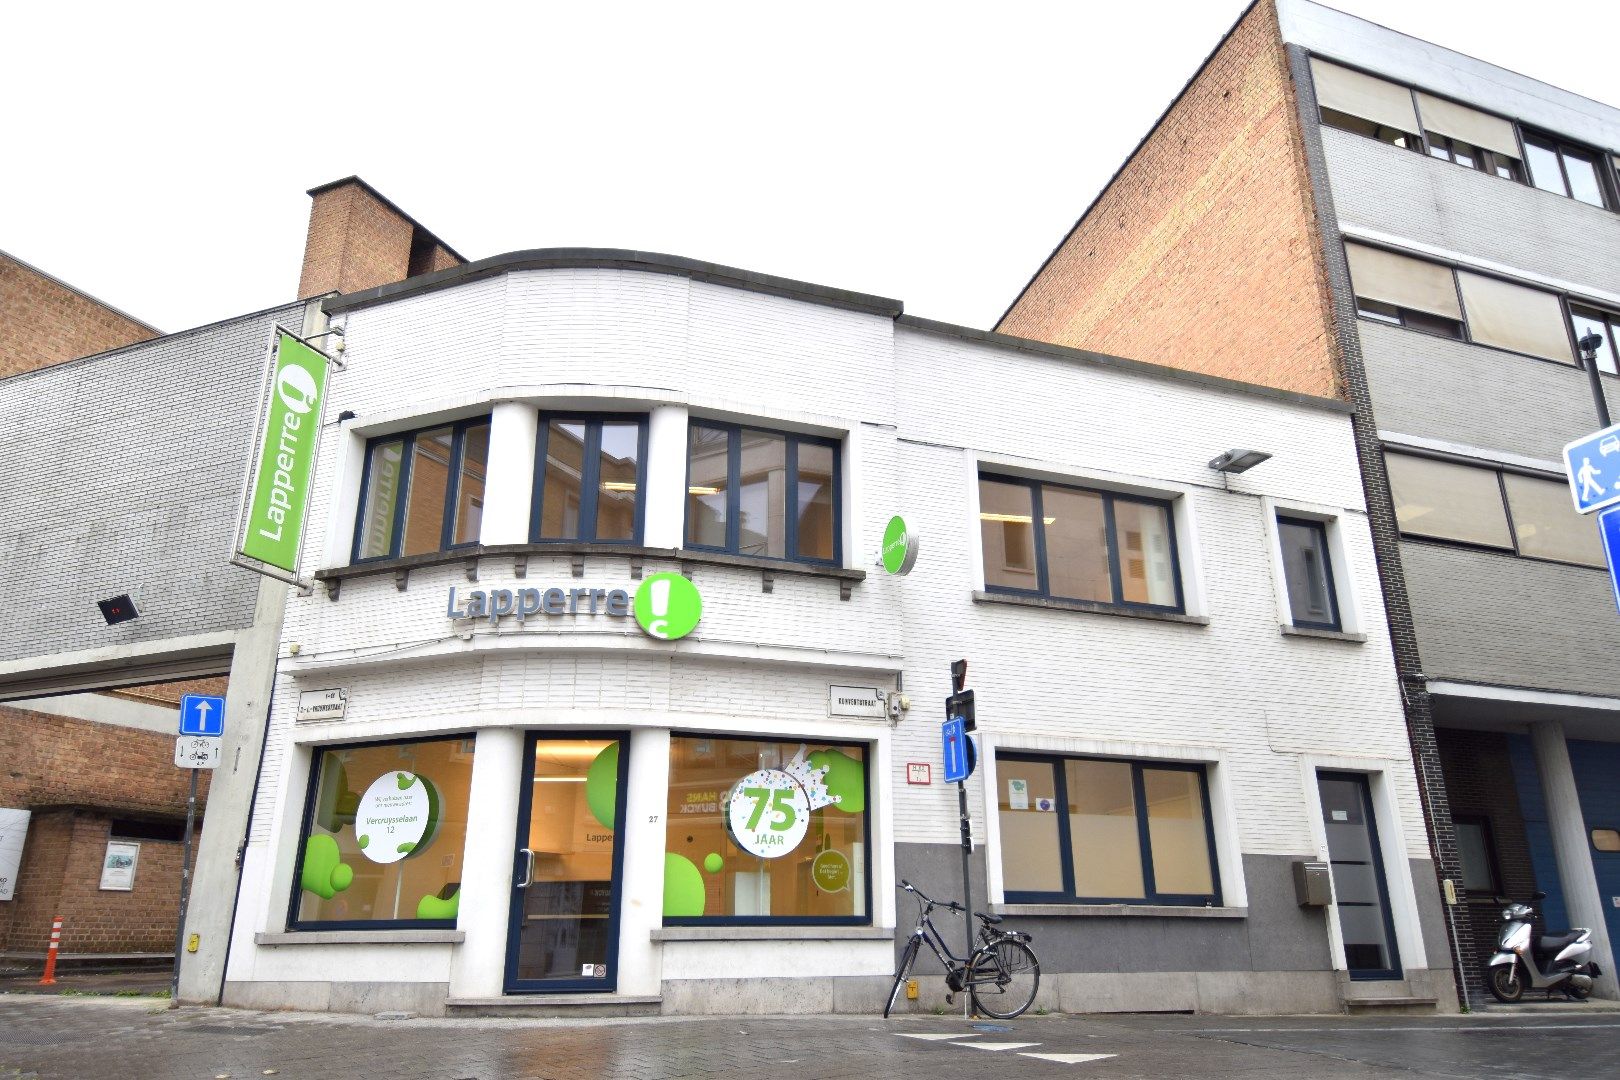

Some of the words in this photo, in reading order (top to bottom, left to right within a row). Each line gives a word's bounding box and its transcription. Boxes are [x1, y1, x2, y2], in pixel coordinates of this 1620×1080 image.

[260, 412, 300, 541] Lapperre
[447, 586, 629, 624] Lapperre
[744, 787, 796, 831] 75
[366, 815, 418, 825] Vercruysselaan
[648, 815, 659, 823] 27
[386, 826, 395, 834] 12
[755, 834, 784, 845] JAAR
